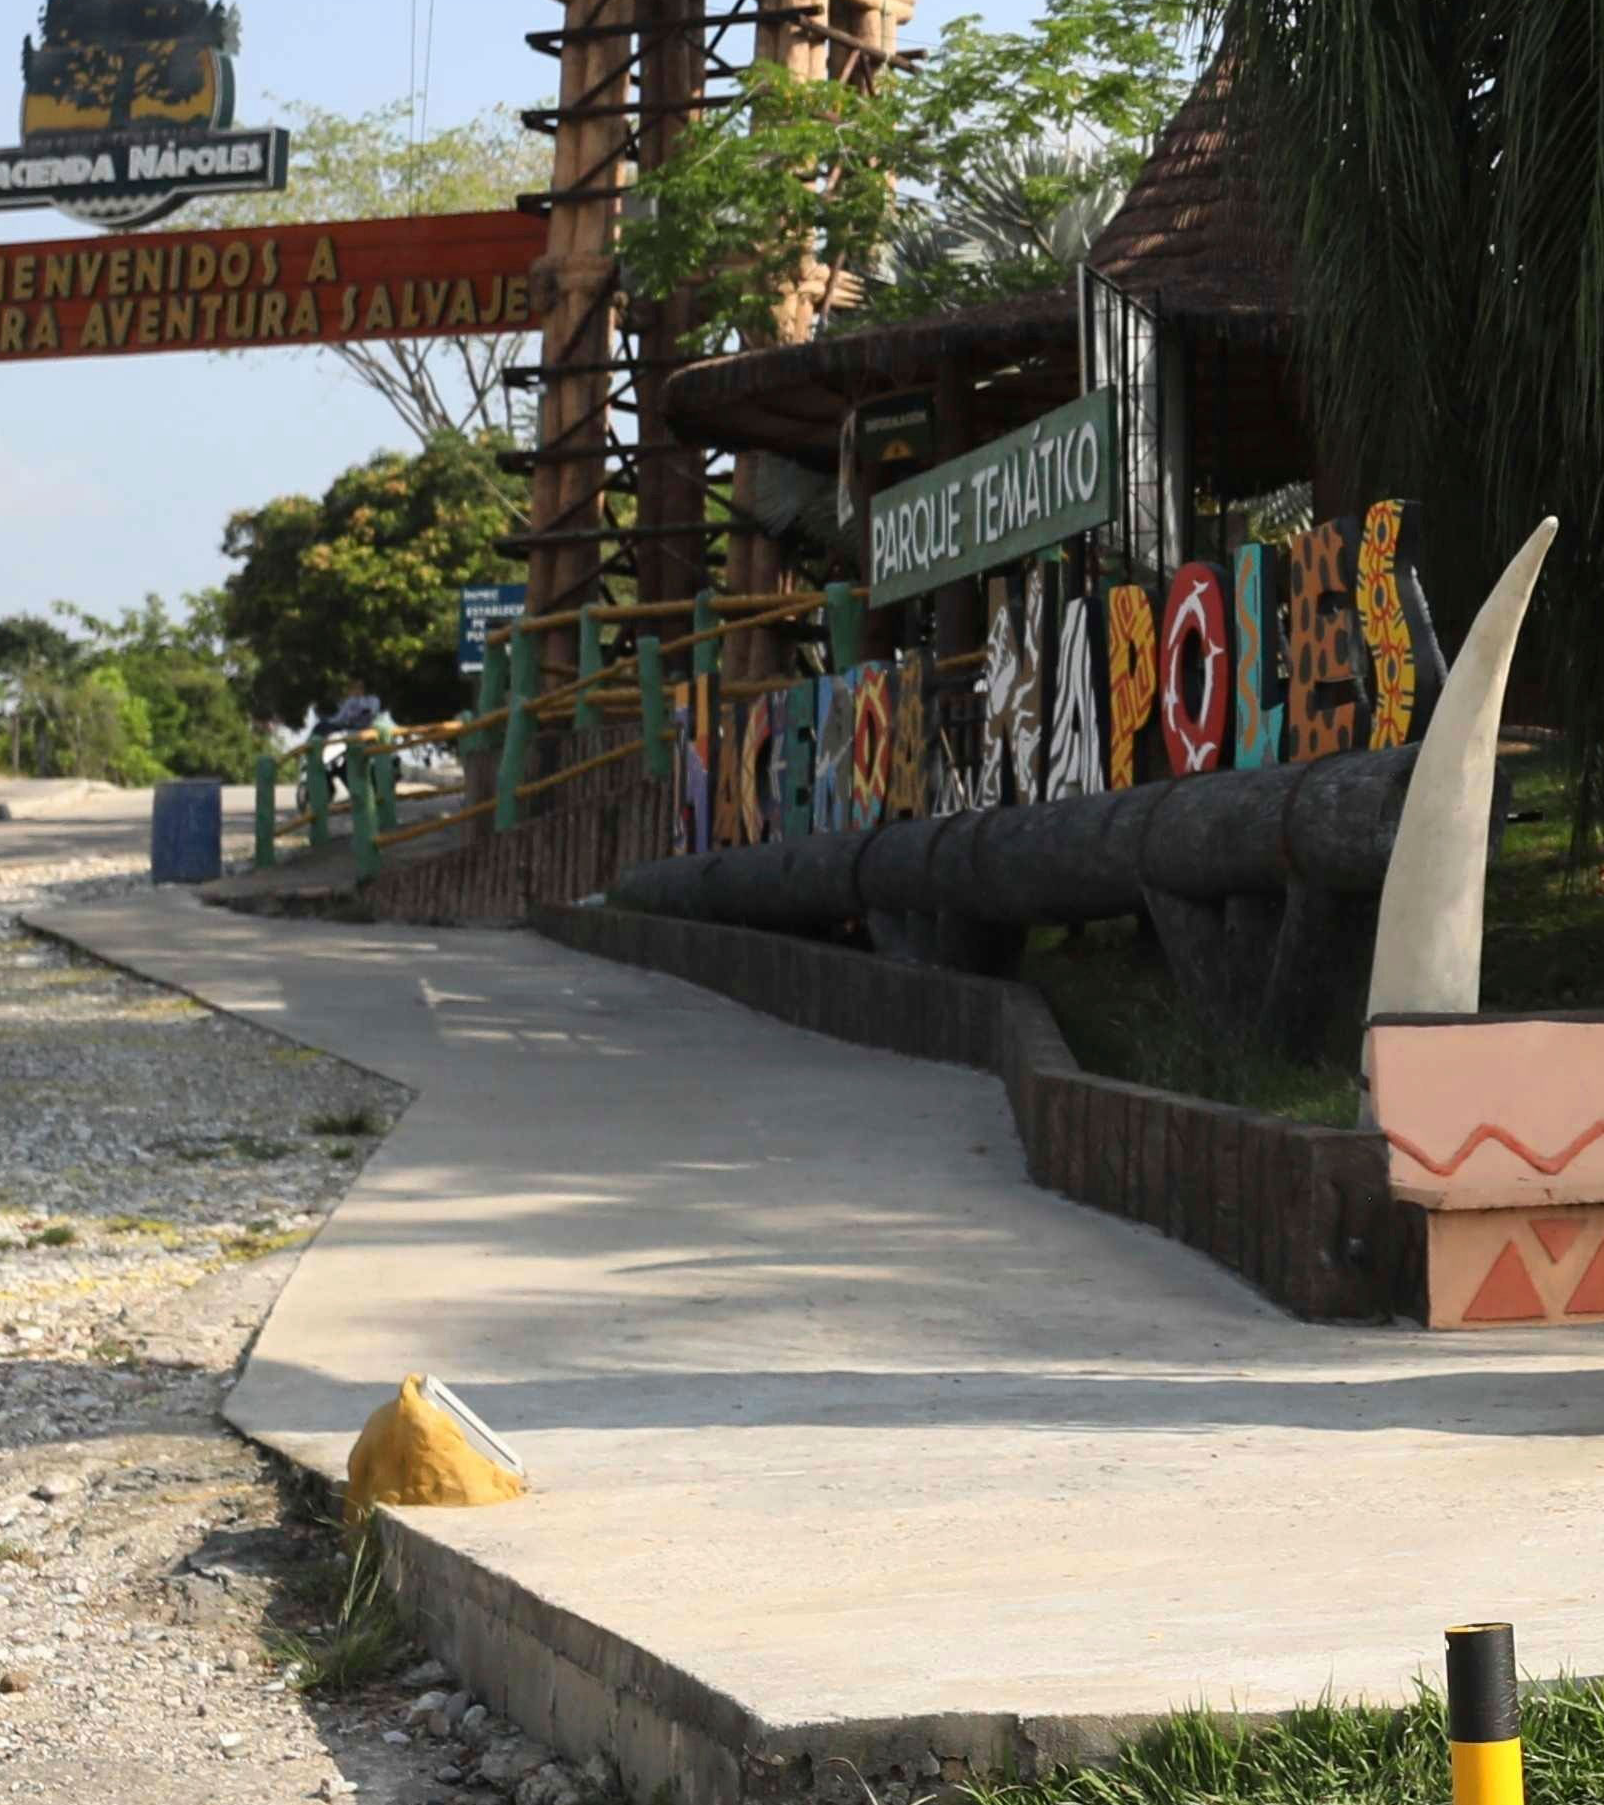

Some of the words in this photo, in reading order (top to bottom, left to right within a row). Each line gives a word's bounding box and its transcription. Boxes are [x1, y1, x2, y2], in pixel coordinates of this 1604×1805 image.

[128, 141, 264, 181] NÁPOLES
[306, 236, 338, 283] A
[78, 289, 321, 349] AVENTURA
[339, 275, 530, 334] SALVAJE
[871, 481, 962, 585] PARQUE
[970, 421, 1098, 545] TEMÁTICO
